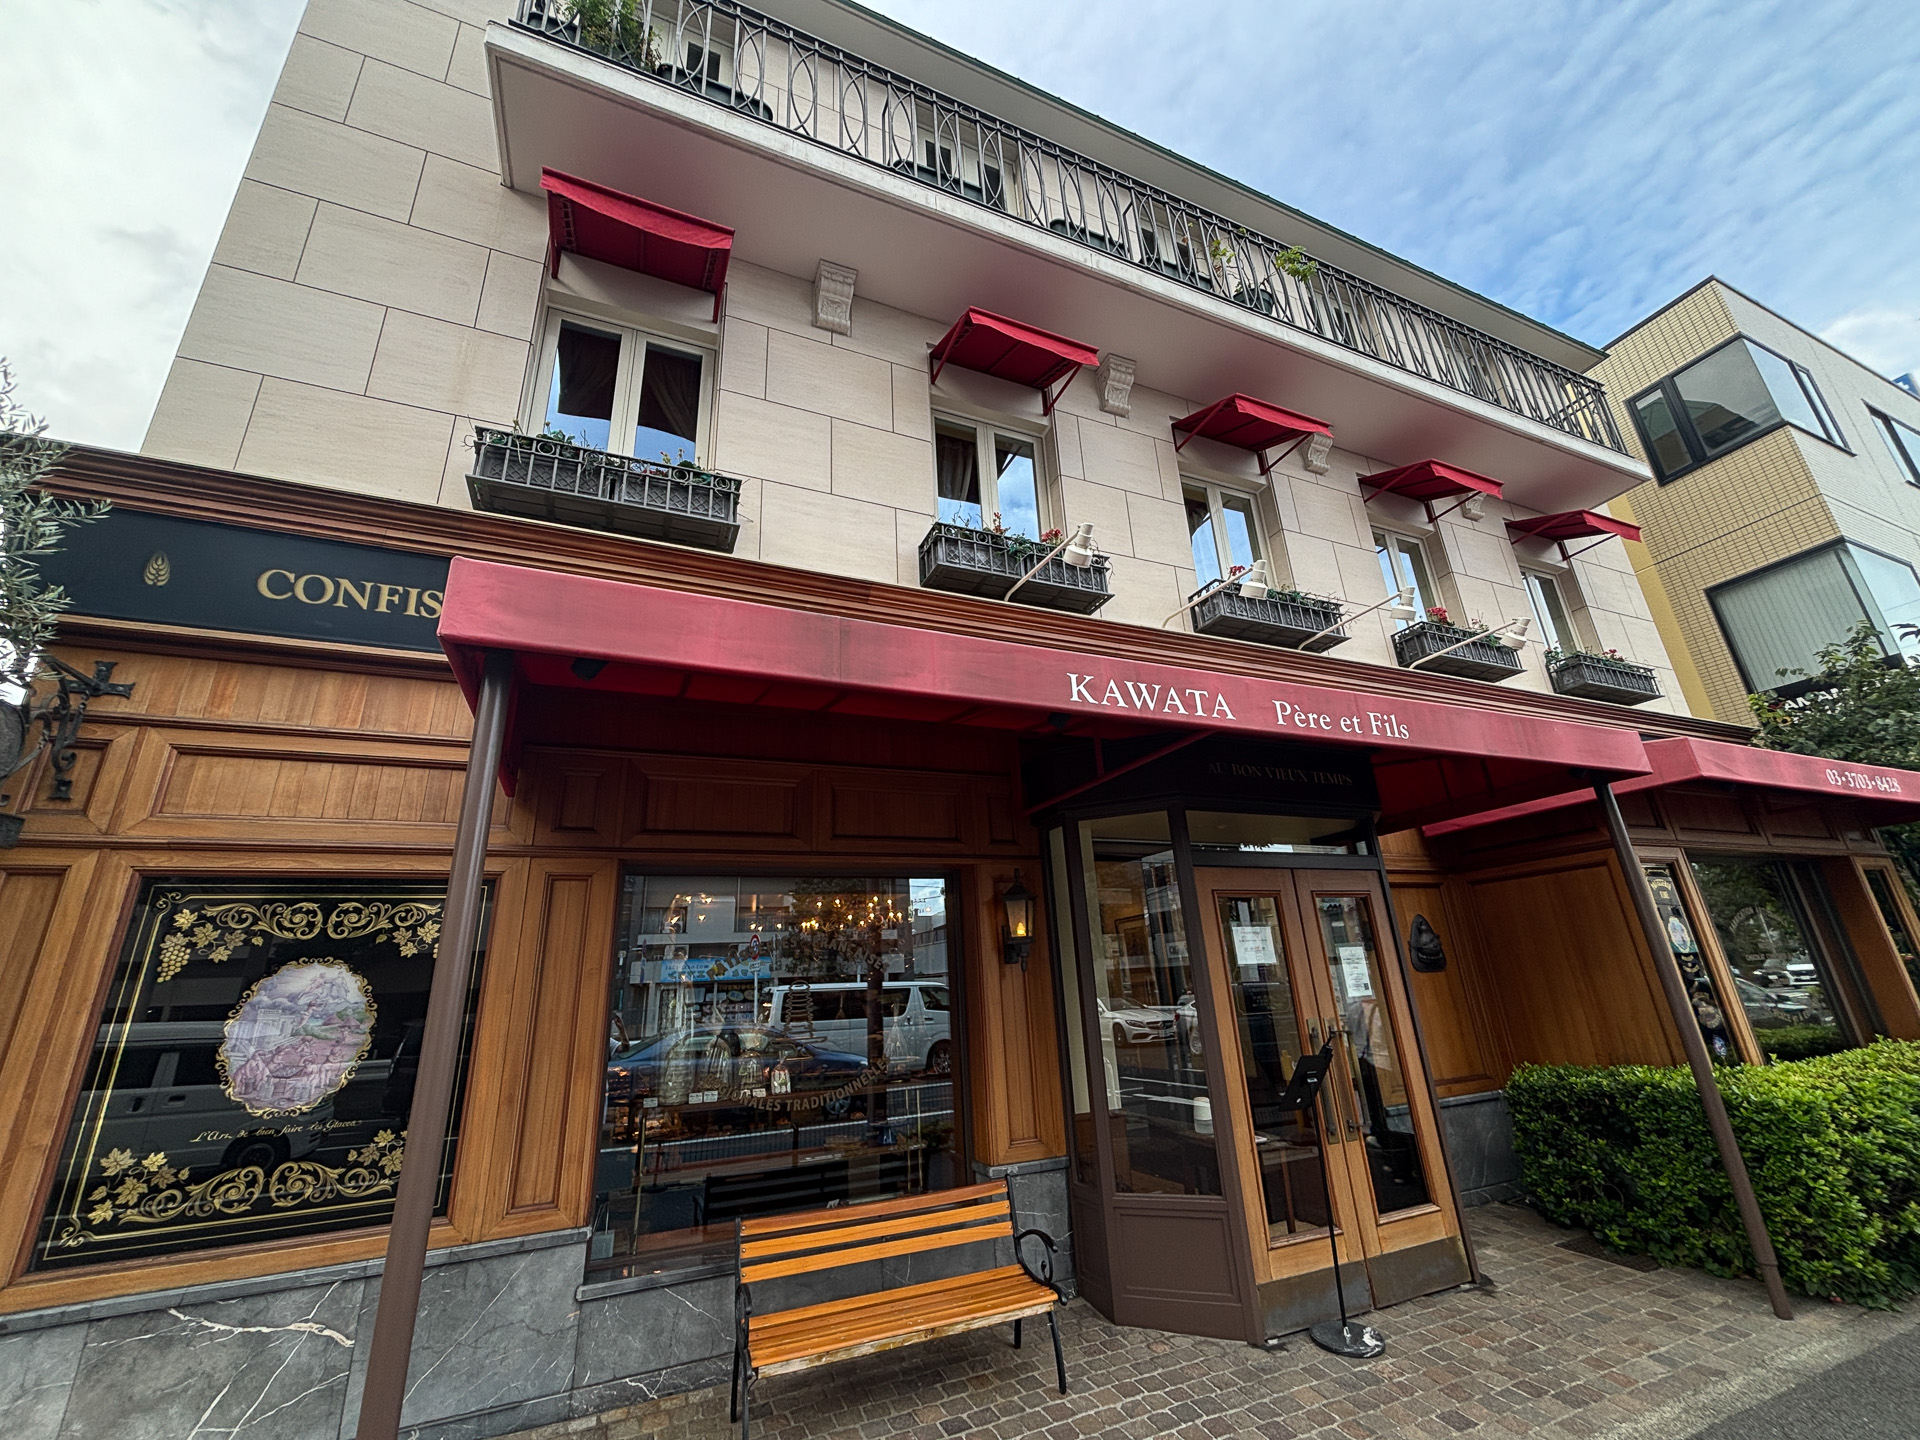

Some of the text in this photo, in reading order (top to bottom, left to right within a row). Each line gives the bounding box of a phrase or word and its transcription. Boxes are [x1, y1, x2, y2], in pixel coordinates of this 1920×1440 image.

[1066, 672, 1410, 739] KAWATA Père et Fils
[1208, 761, 1353, 785] AU BON VIEUX TEMPS
